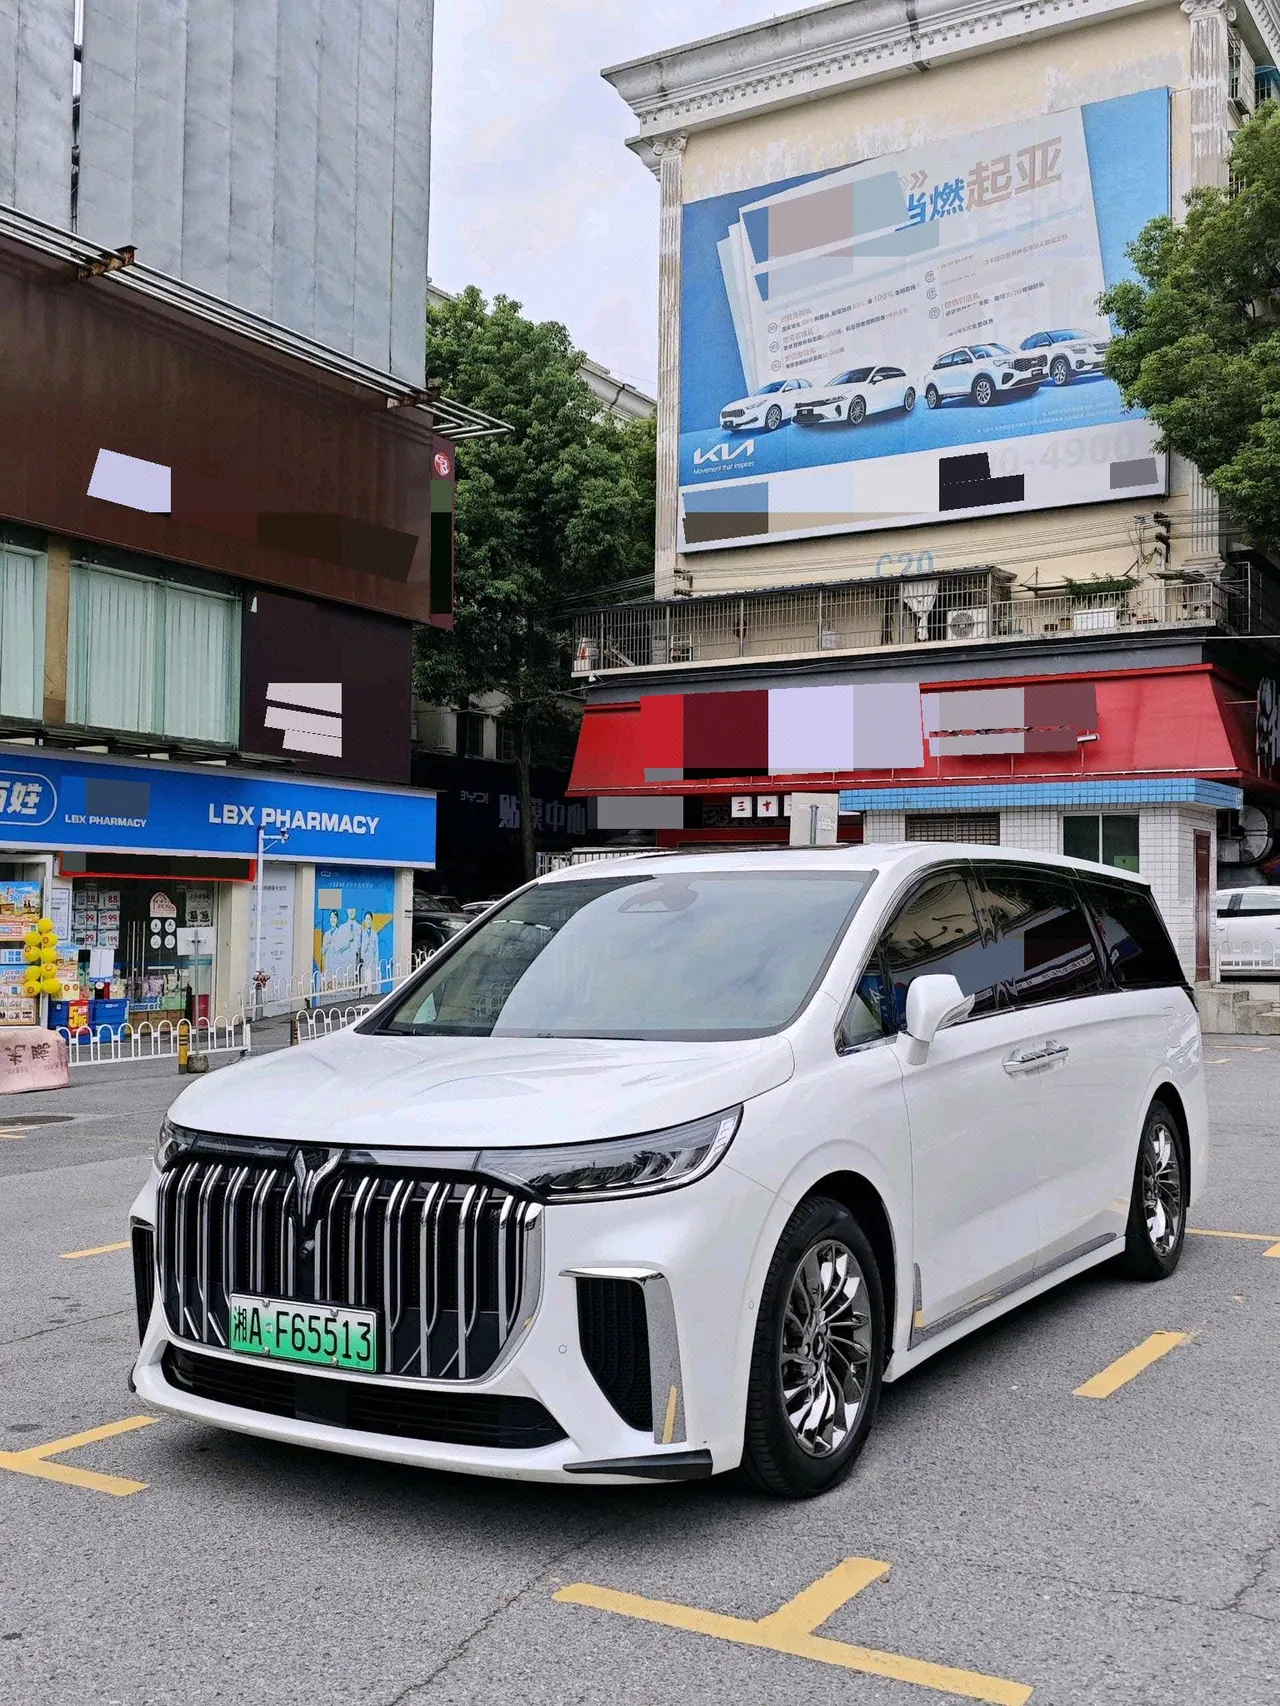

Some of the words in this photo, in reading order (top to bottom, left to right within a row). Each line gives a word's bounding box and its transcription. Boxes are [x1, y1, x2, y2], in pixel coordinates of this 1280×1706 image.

[694, 439, 754, 465] KIA
[694, 467, 721, 475] Movement
[733, 461, 754, 469] inspires
[65, 814, 87, 824] LBX
[89, 815, 147, 828] PHARMACY
[208, 803, 254, 826] LBX
[261, 807, 380, 835] PHARMACY
